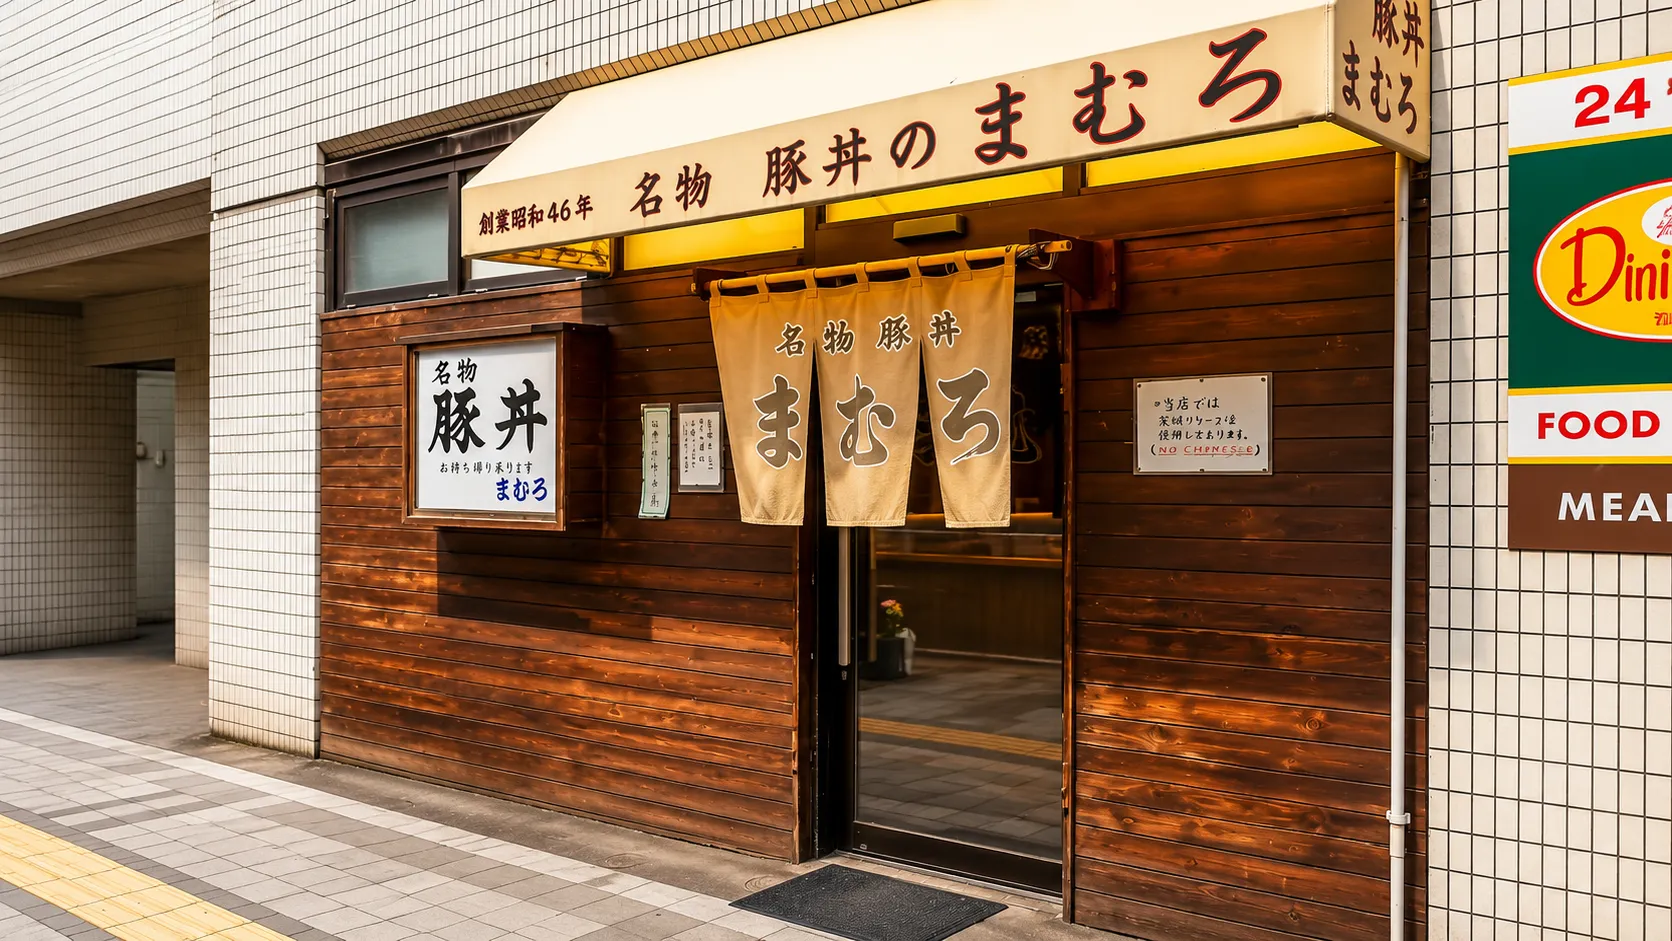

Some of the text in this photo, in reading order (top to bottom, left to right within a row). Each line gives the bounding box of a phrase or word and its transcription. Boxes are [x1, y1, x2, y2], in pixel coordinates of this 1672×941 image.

[1372, 0, 1425, 68] 豚丼
[1342, 39, 1418, 135] まむろ
[1574, 77, 1651, 128] 24
[478, 194, 594, 236] 創業昭和46年
[629, 162, 712, 218] 名物
[432, 357, 477, 385] 名物
[427, 378, 548, 454] 豚丼
[753, 367, 1001, 470] まむろ
[1537, 410, 1661, 440] FOOD
[495, 477, 548, 502] まむろ
